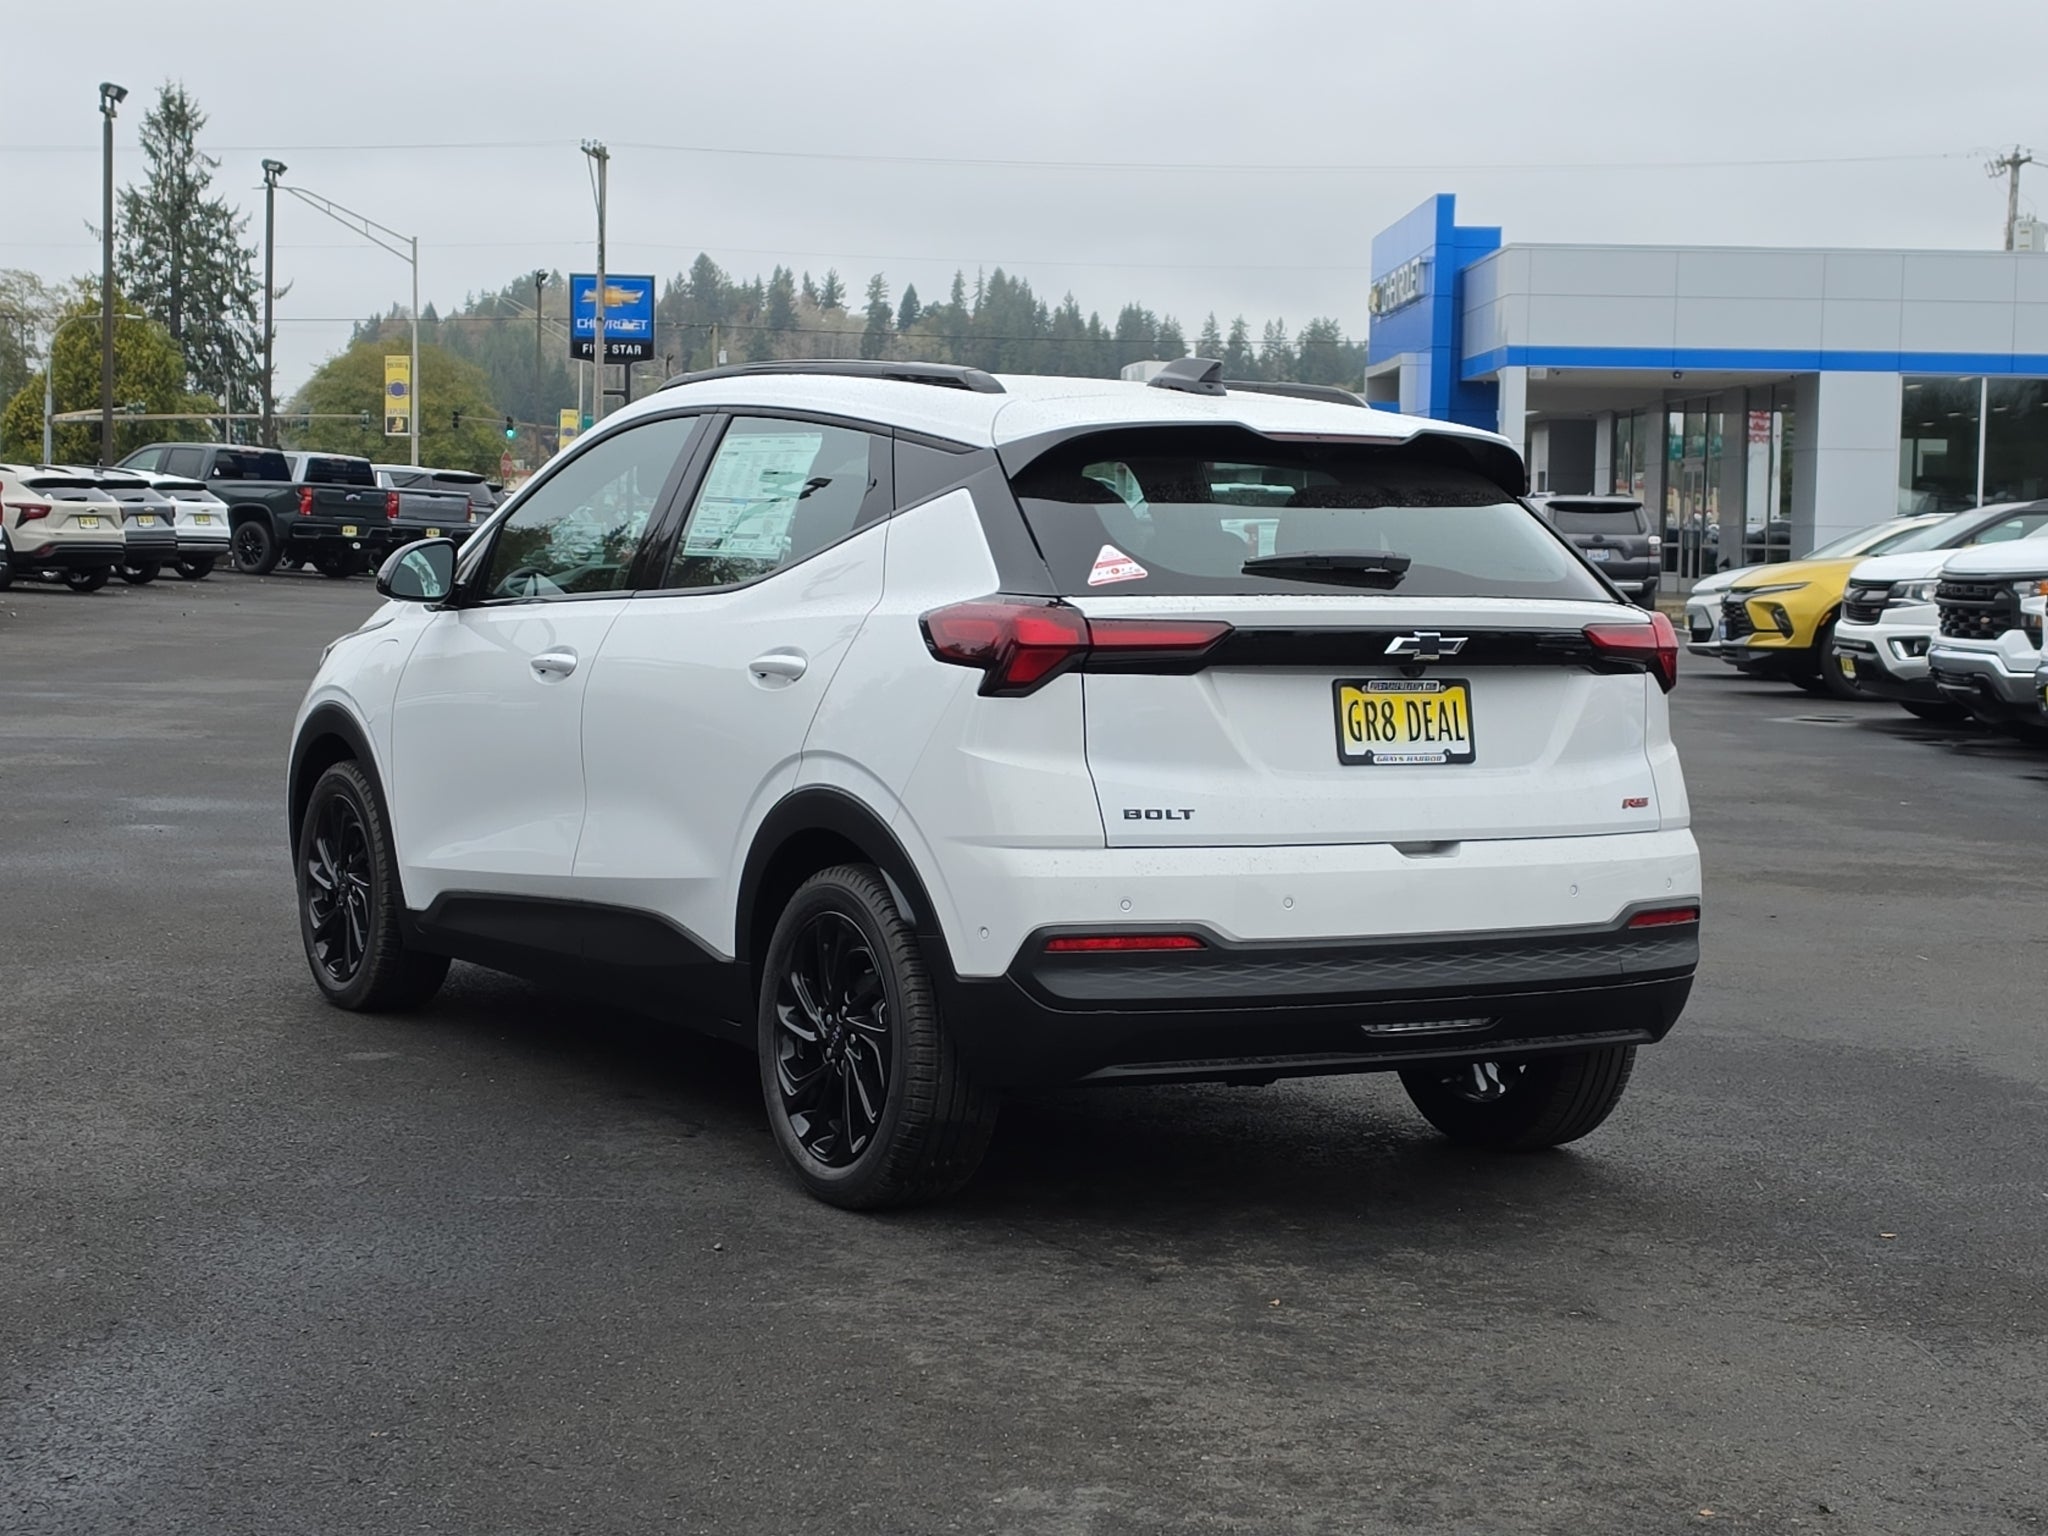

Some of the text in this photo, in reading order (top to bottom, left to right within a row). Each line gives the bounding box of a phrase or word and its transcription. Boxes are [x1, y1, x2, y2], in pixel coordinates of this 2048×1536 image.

[612, 344, 641, 355] STAR
[1348, 700, 1465, 742] GR8 DEAL
[1621, 797, 1649, 809] RS
[1122, 808, 1196, 820] BOLT
